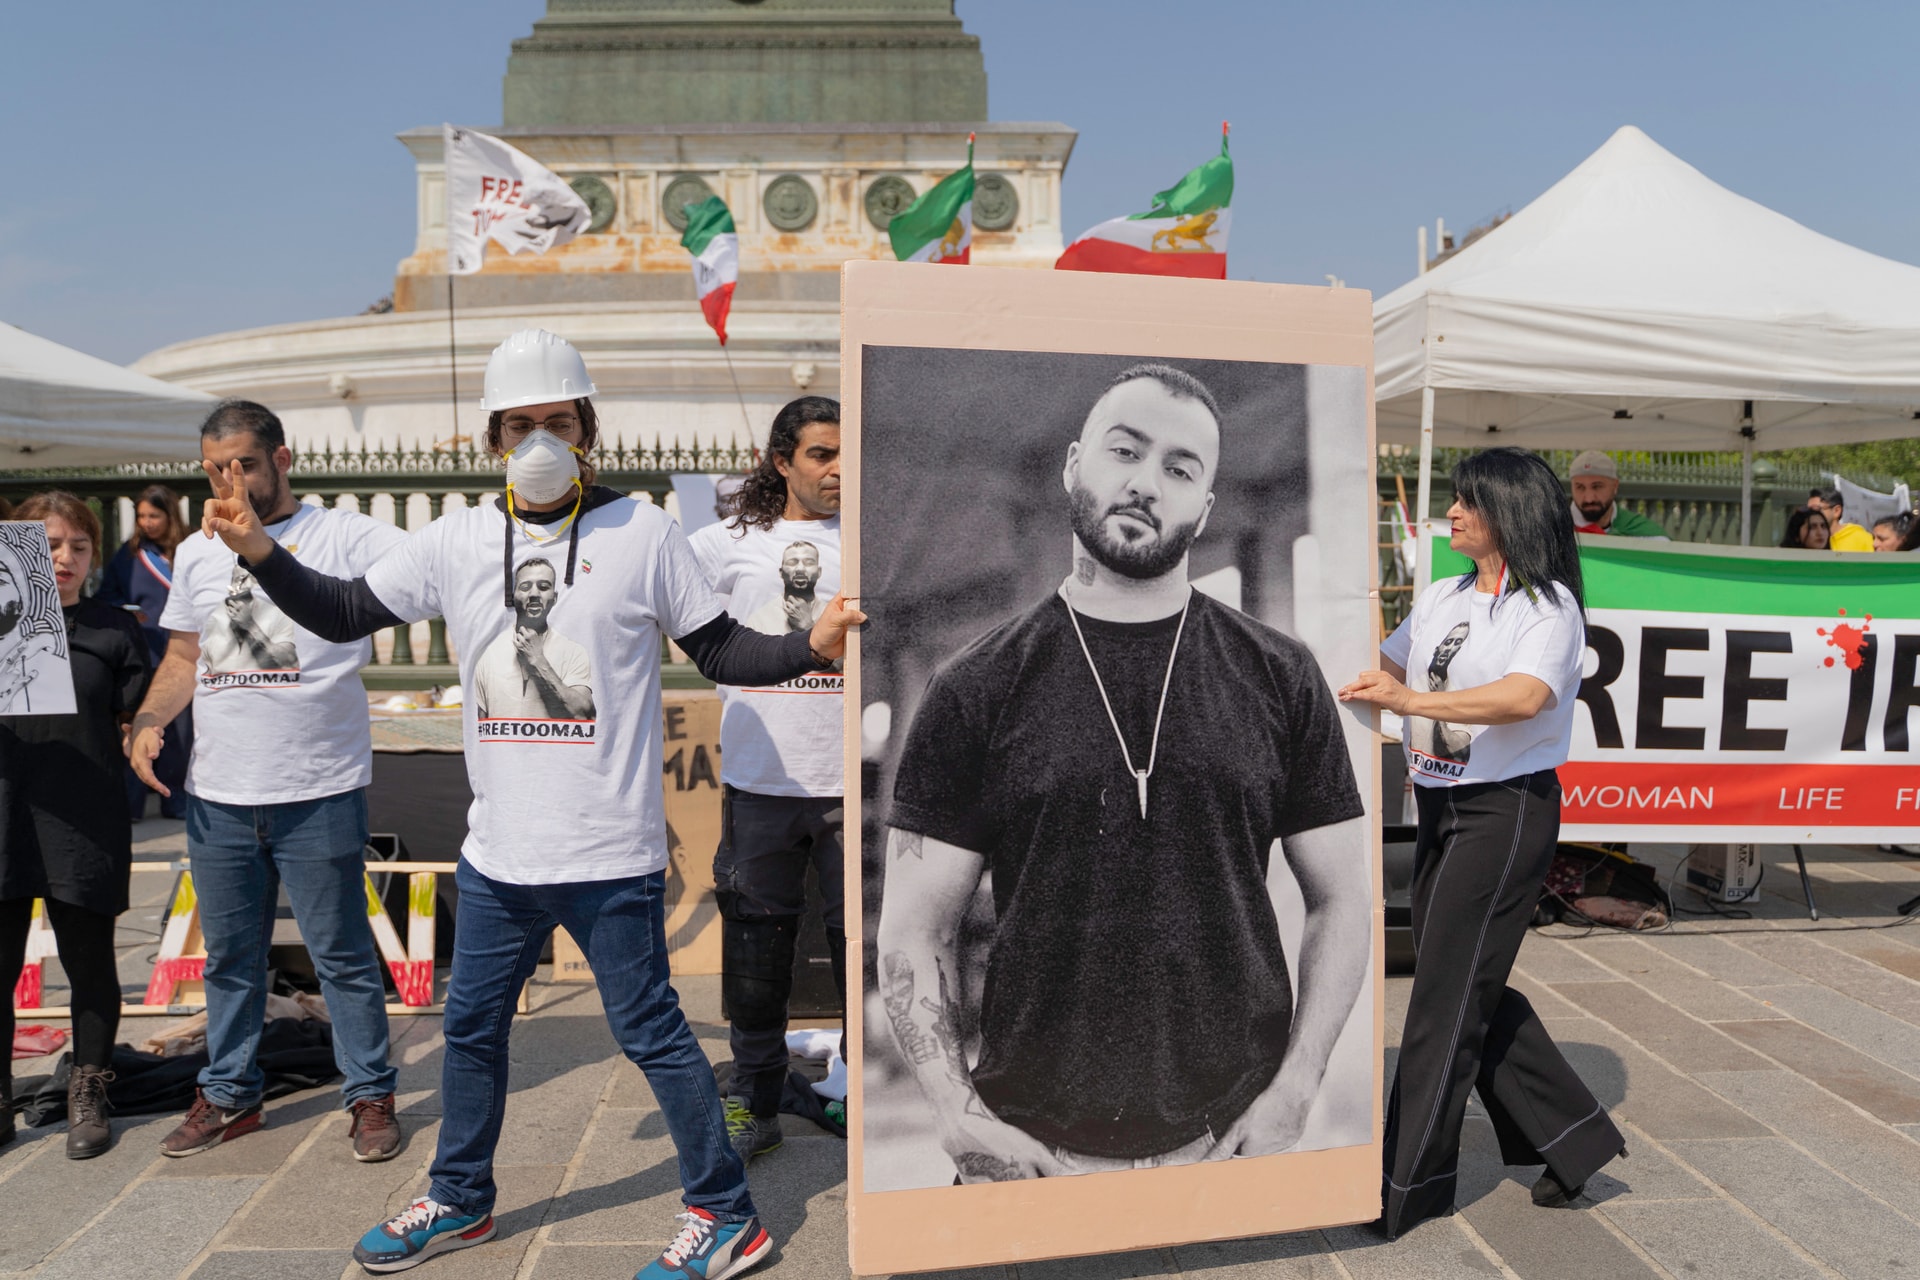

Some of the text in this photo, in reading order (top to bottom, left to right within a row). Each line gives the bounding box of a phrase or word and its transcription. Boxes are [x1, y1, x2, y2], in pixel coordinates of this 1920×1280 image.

[662, 744, 722, 792] MA
[1561, 786, 1920, 810] WOMAN LIFE F
